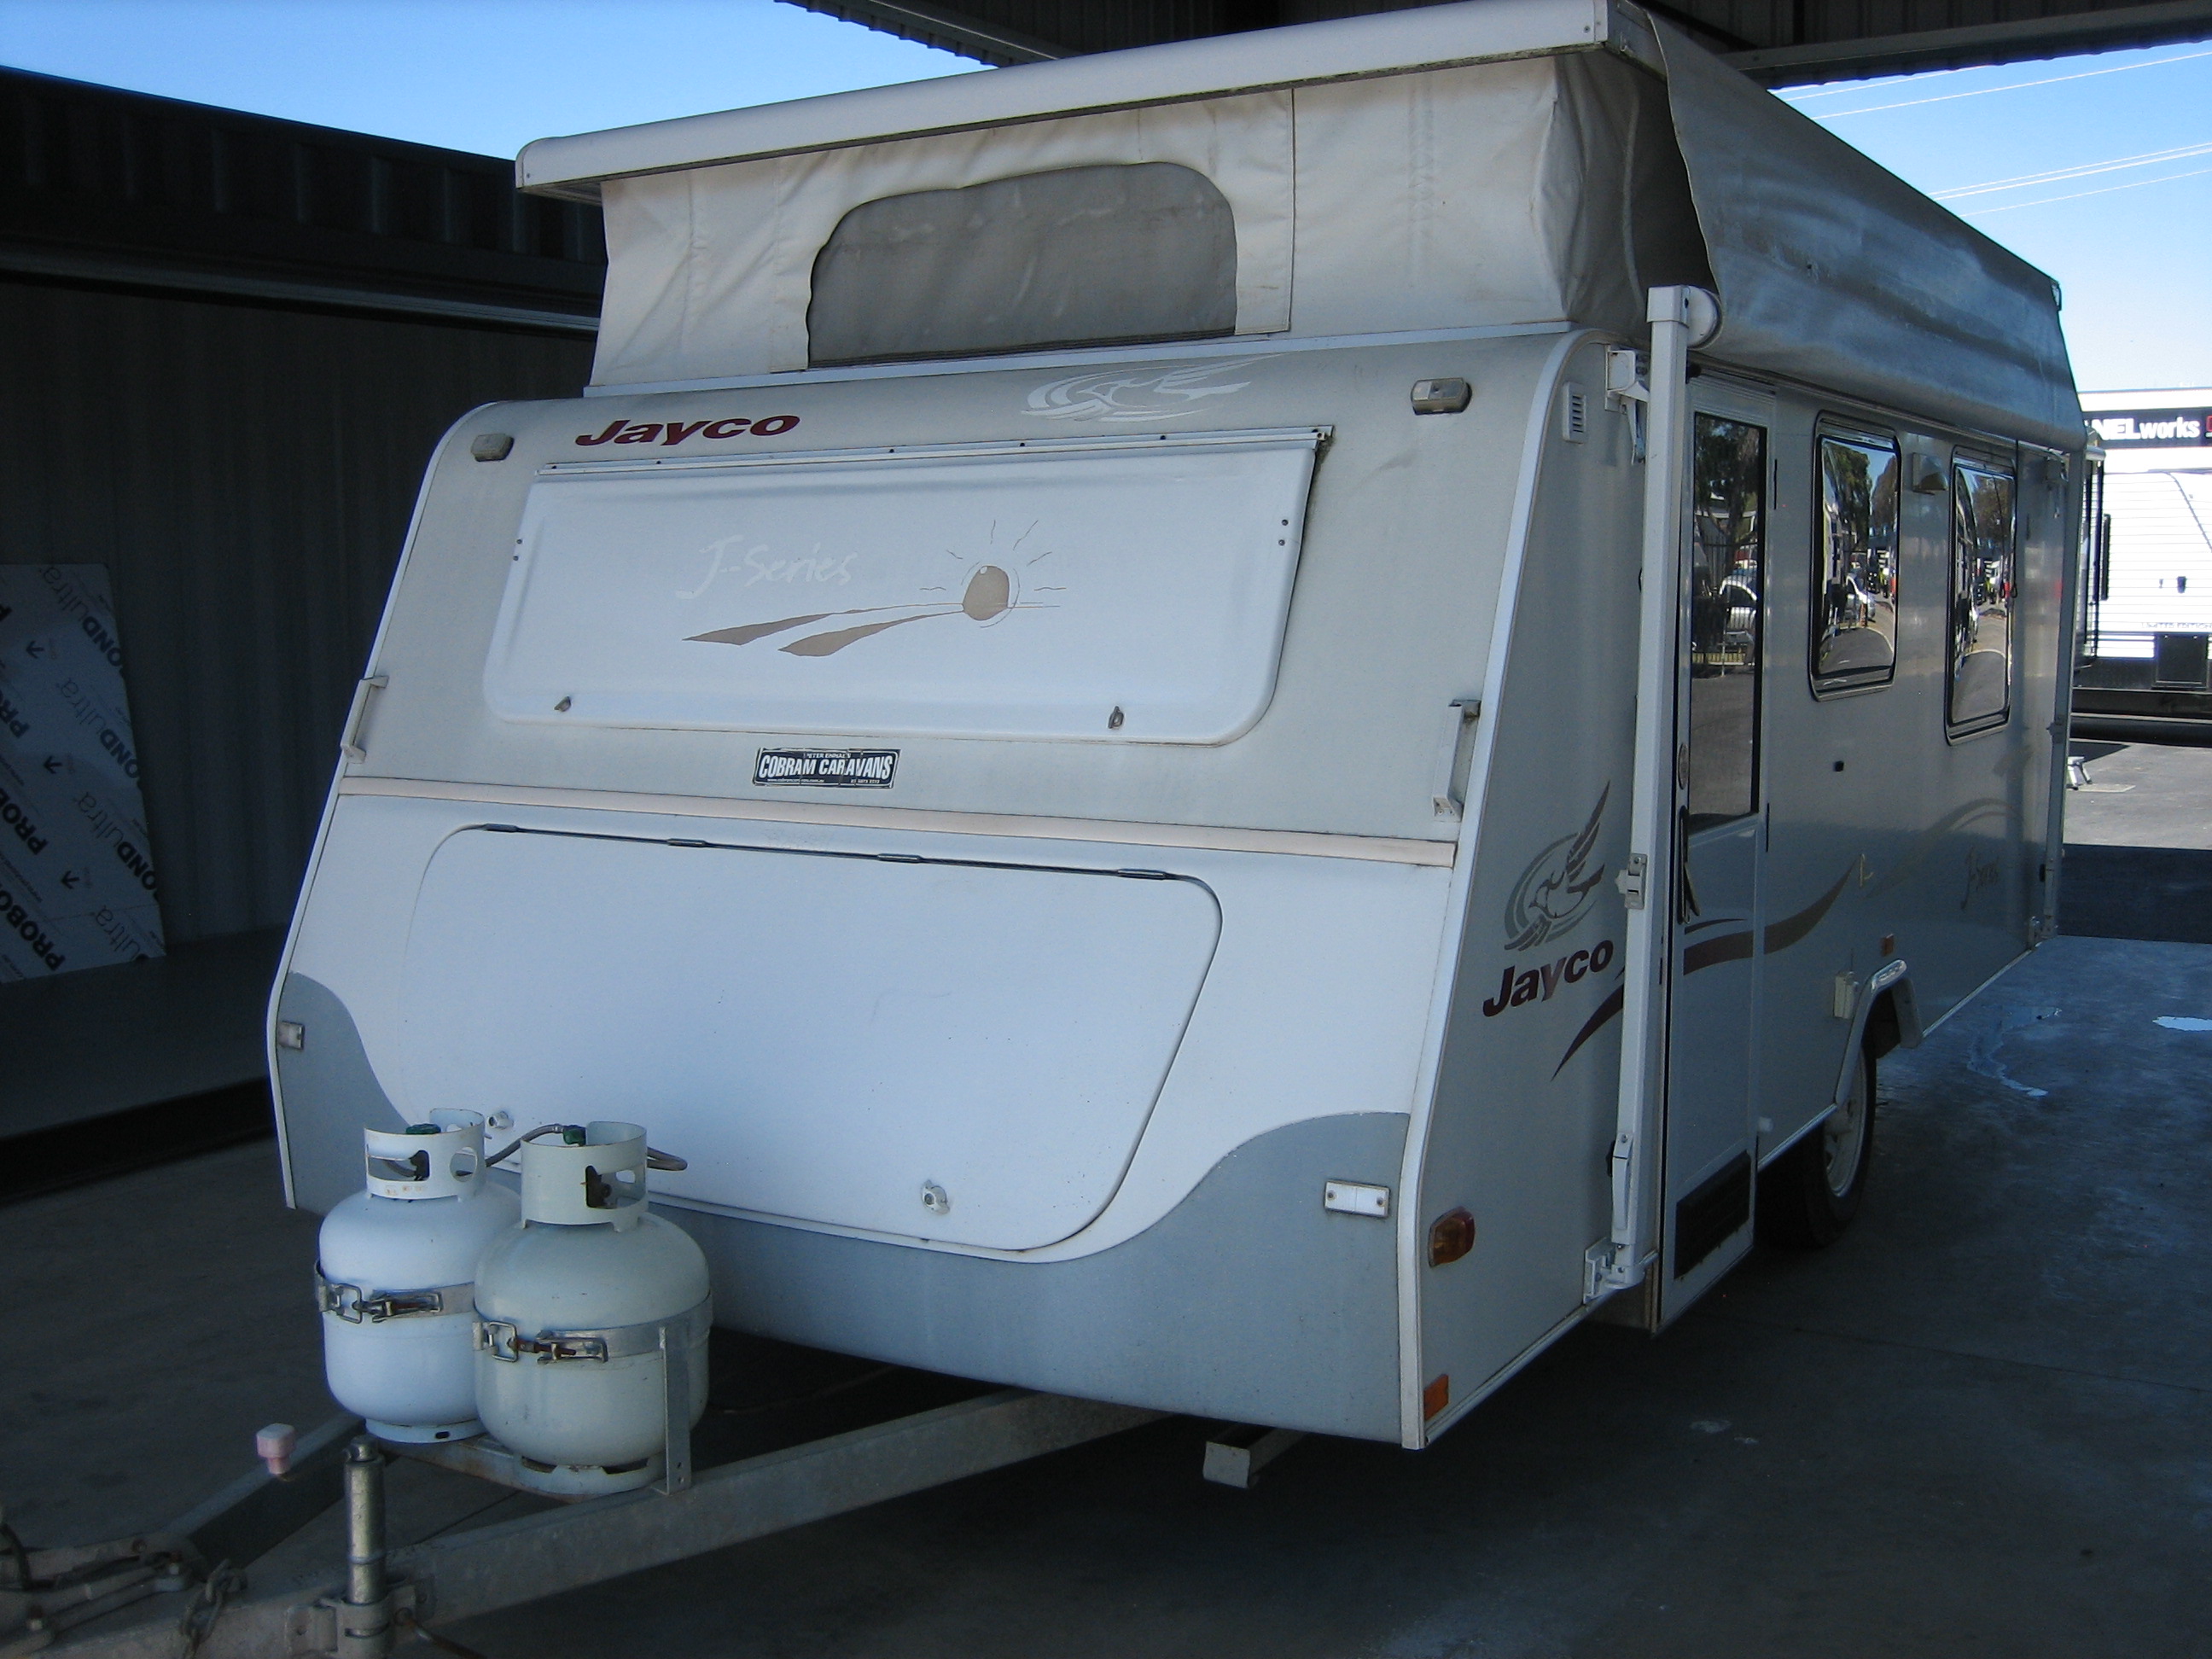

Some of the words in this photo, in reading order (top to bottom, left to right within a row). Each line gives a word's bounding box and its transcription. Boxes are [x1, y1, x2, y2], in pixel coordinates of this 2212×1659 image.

[575, 415, 800, 446] Jayco
[2084, 416, 2201, 440] NELworks
[674, 536, 858, 599] J-Series
[759, 754, 816, 778] COBRAM
[818, 755, 893, 780] CARAVANS
[0, 884, 66, 971] PROBO
[1482, 940, 1615, 1018] Jayco
